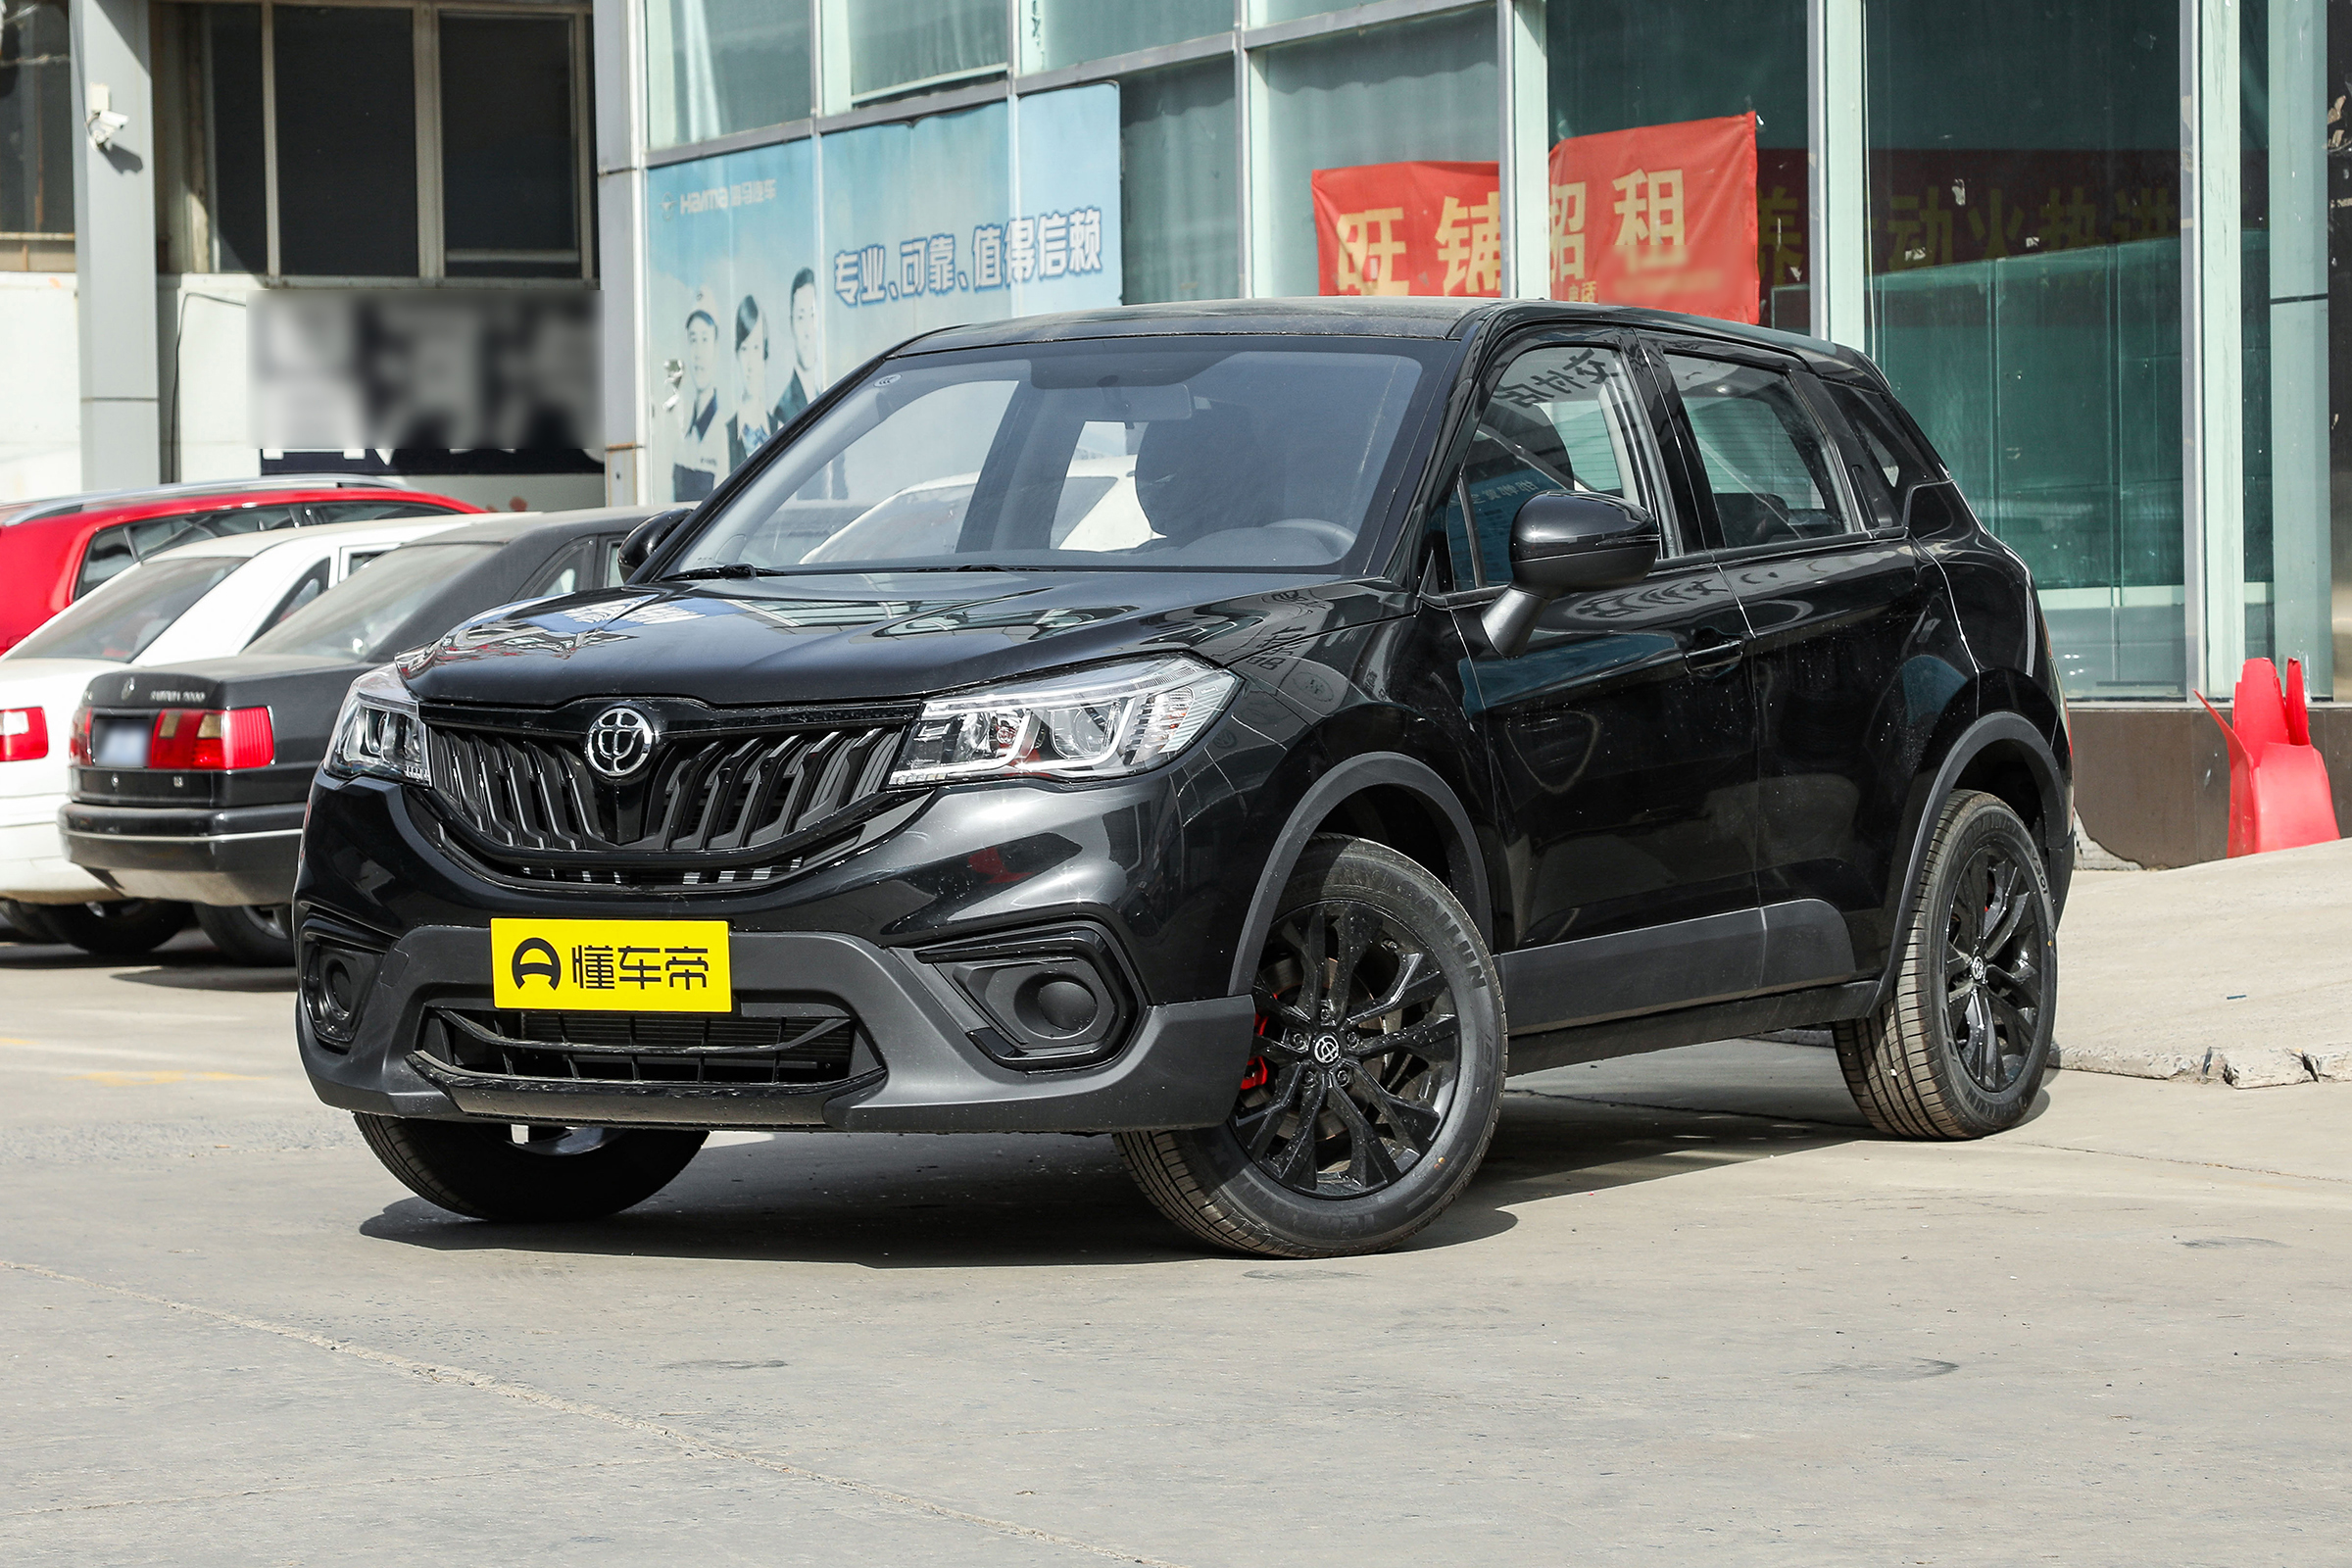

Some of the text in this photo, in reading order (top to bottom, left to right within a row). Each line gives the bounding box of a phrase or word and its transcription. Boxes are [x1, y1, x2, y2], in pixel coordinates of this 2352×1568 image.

[834, 205, 1102, 307] 专业、可靠、值得信赖
[571, 945, 709, 991] 懂车帝
